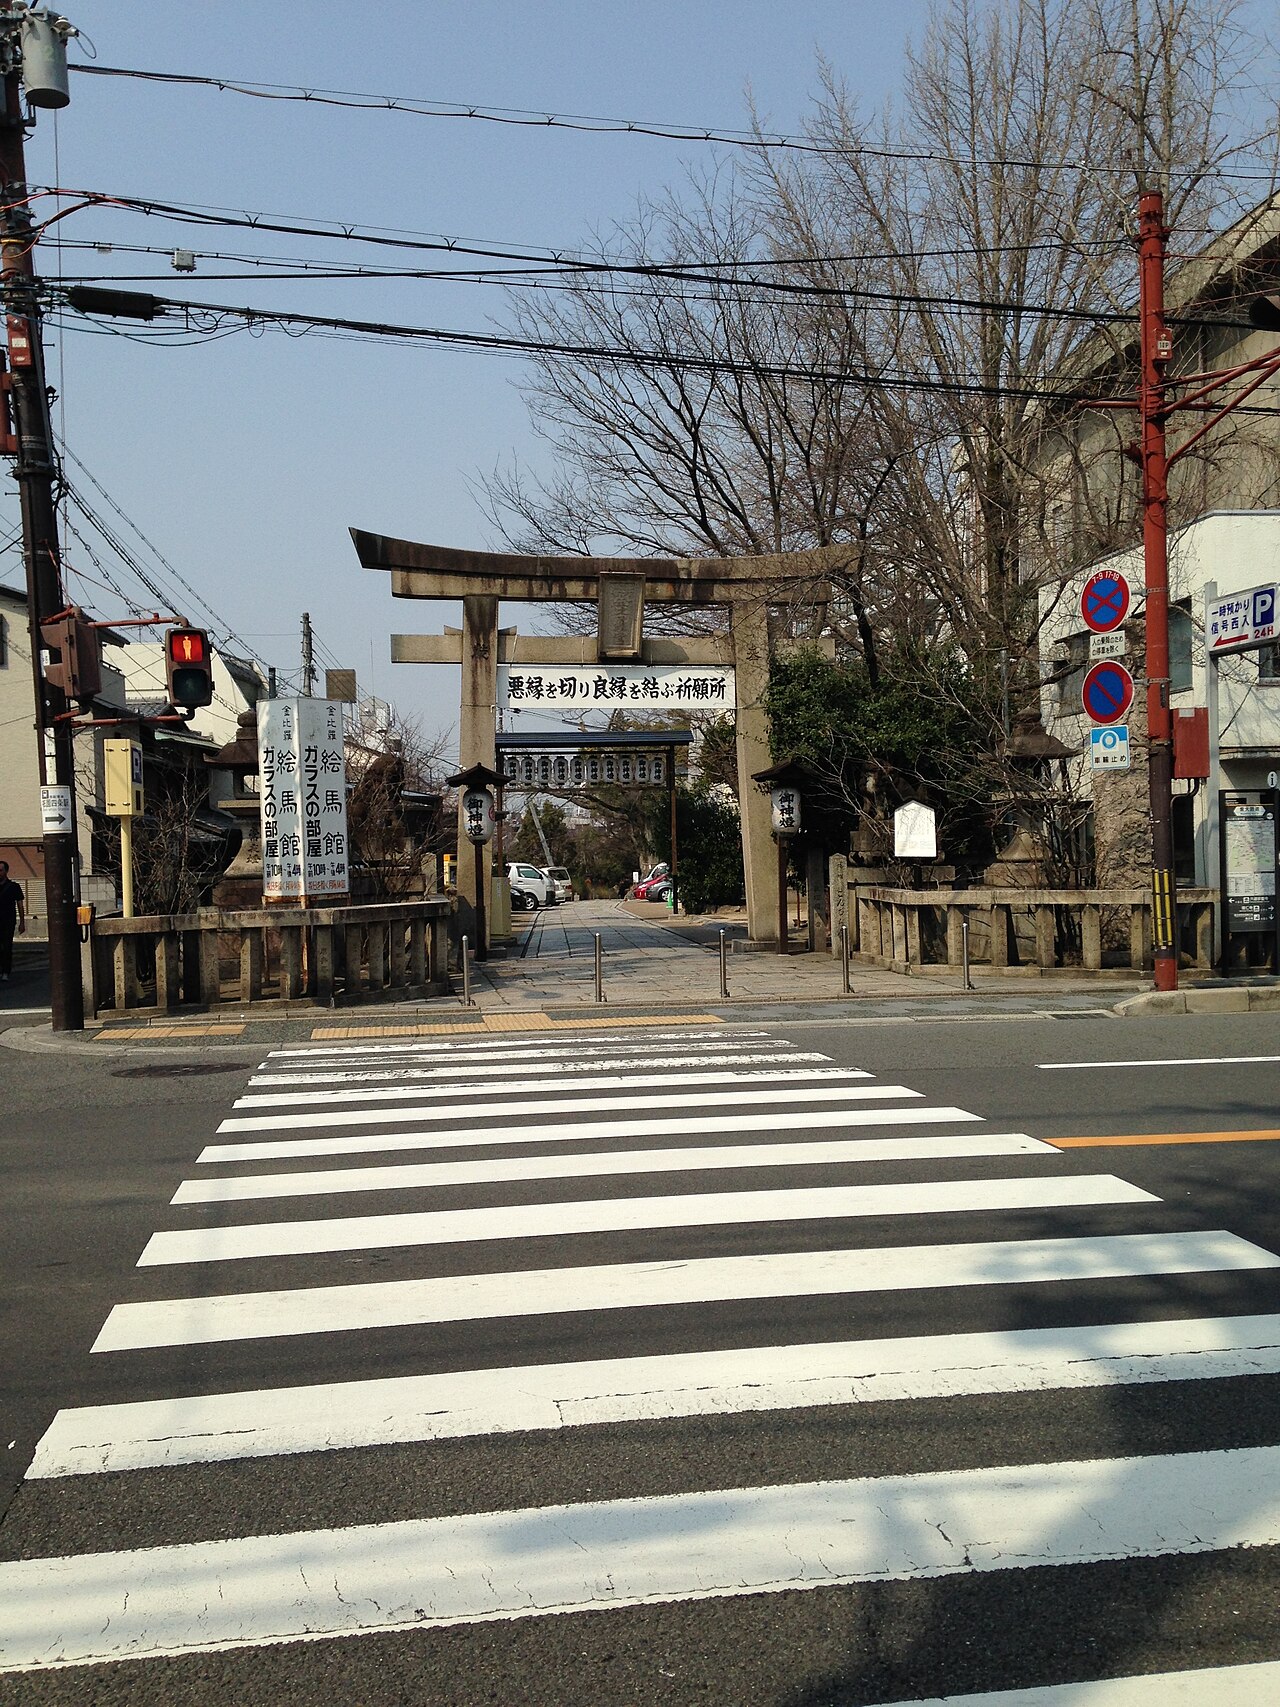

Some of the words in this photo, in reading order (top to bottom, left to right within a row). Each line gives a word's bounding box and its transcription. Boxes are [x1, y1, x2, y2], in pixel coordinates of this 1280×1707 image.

[1092, 572, 1103, 584] 7-9
[1105, 570, 1120, 582] 17-19
[1211, 599, 1250, 616] 一時預かり
[1256, 593, 1273, 623] P
[1254, 626, 1274, 639] 24H
[507, 674, 727, 700] 悪縁を切り良縁を結ぶ祈願所
[263, 745, 279, 858] ガラスの部屋
[304, 745, 322, 857] ガラスの部屋
[467, 795, 484, 837] 御神燈
[778, 790, 795, 828] 御神燈
